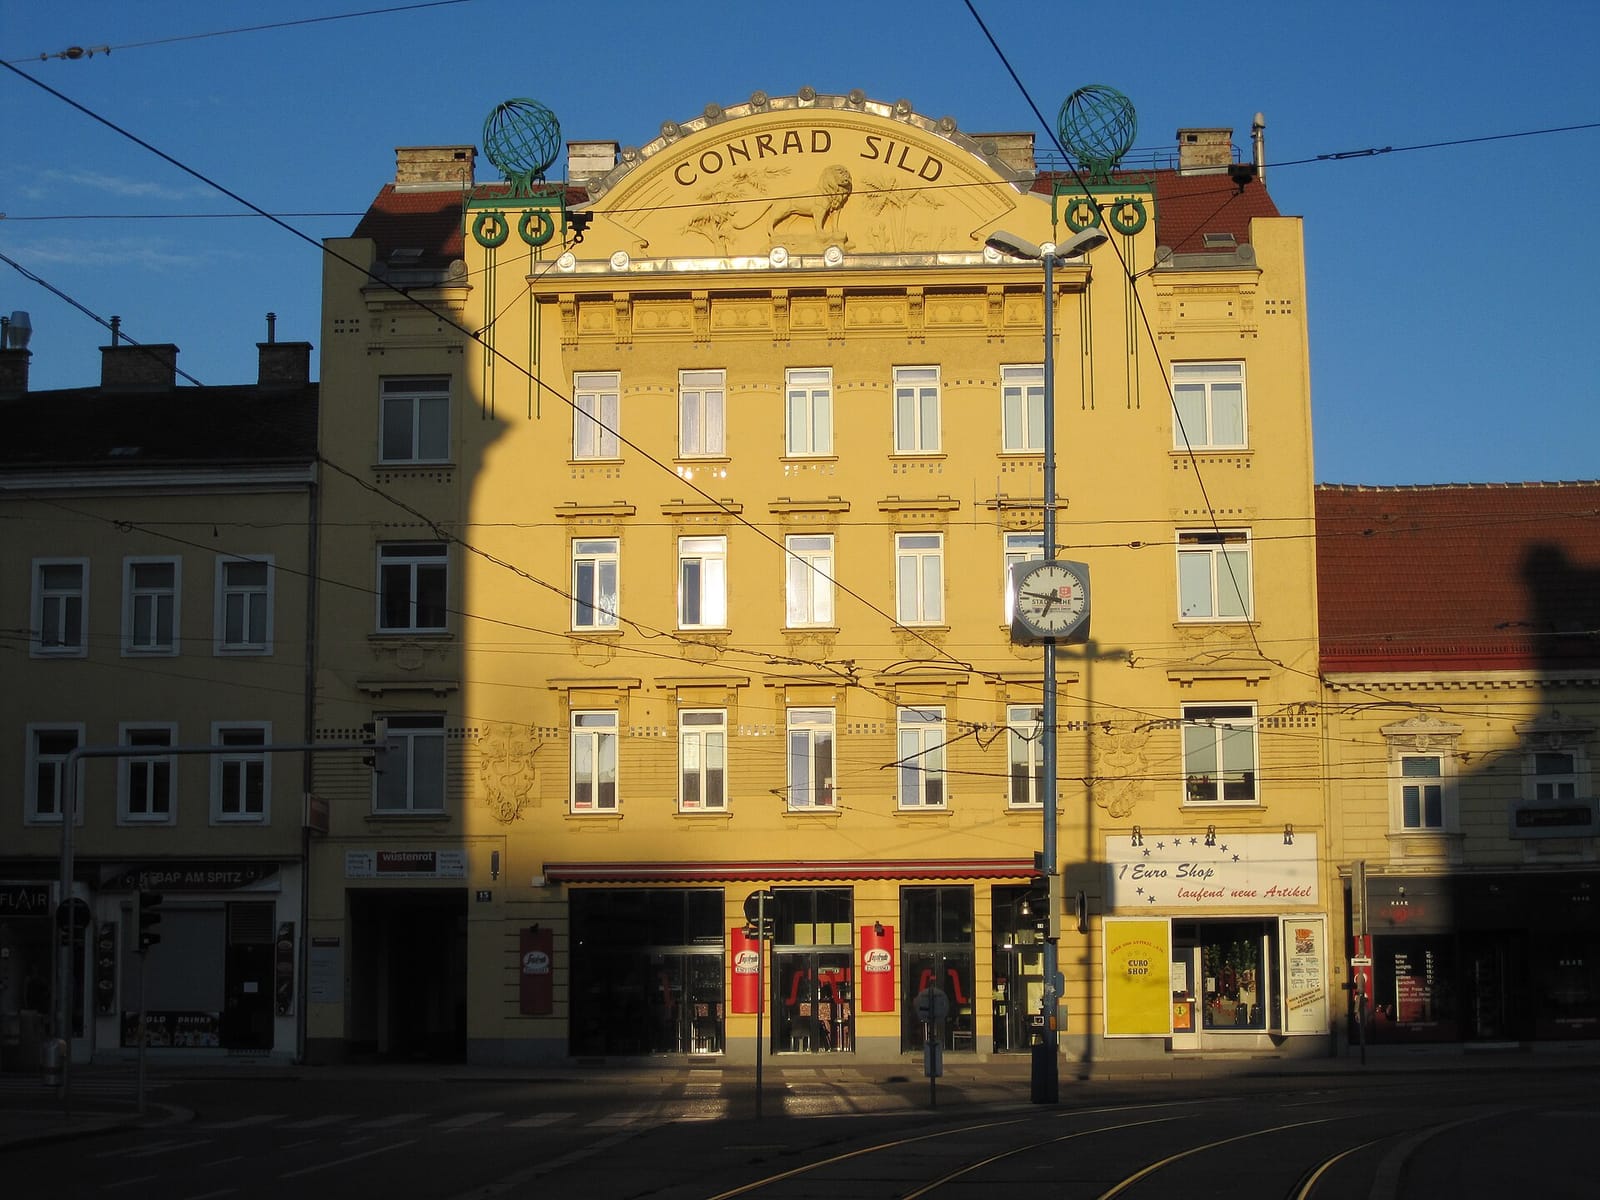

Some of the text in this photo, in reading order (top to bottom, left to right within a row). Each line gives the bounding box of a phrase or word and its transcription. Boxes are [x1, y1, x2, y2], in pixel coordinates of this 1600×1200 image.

[674, 129, 943, 186] CONRAD SILD
[184, 871, 206, 883] AM
[207, 871, 242, 883] SPITZ
[1118, 863, 1215, 880] 1 Euro Shop
[1177, 885, 1312, 902] laufend neue Artikel
[144, 1015, 167, 1024] OLD
